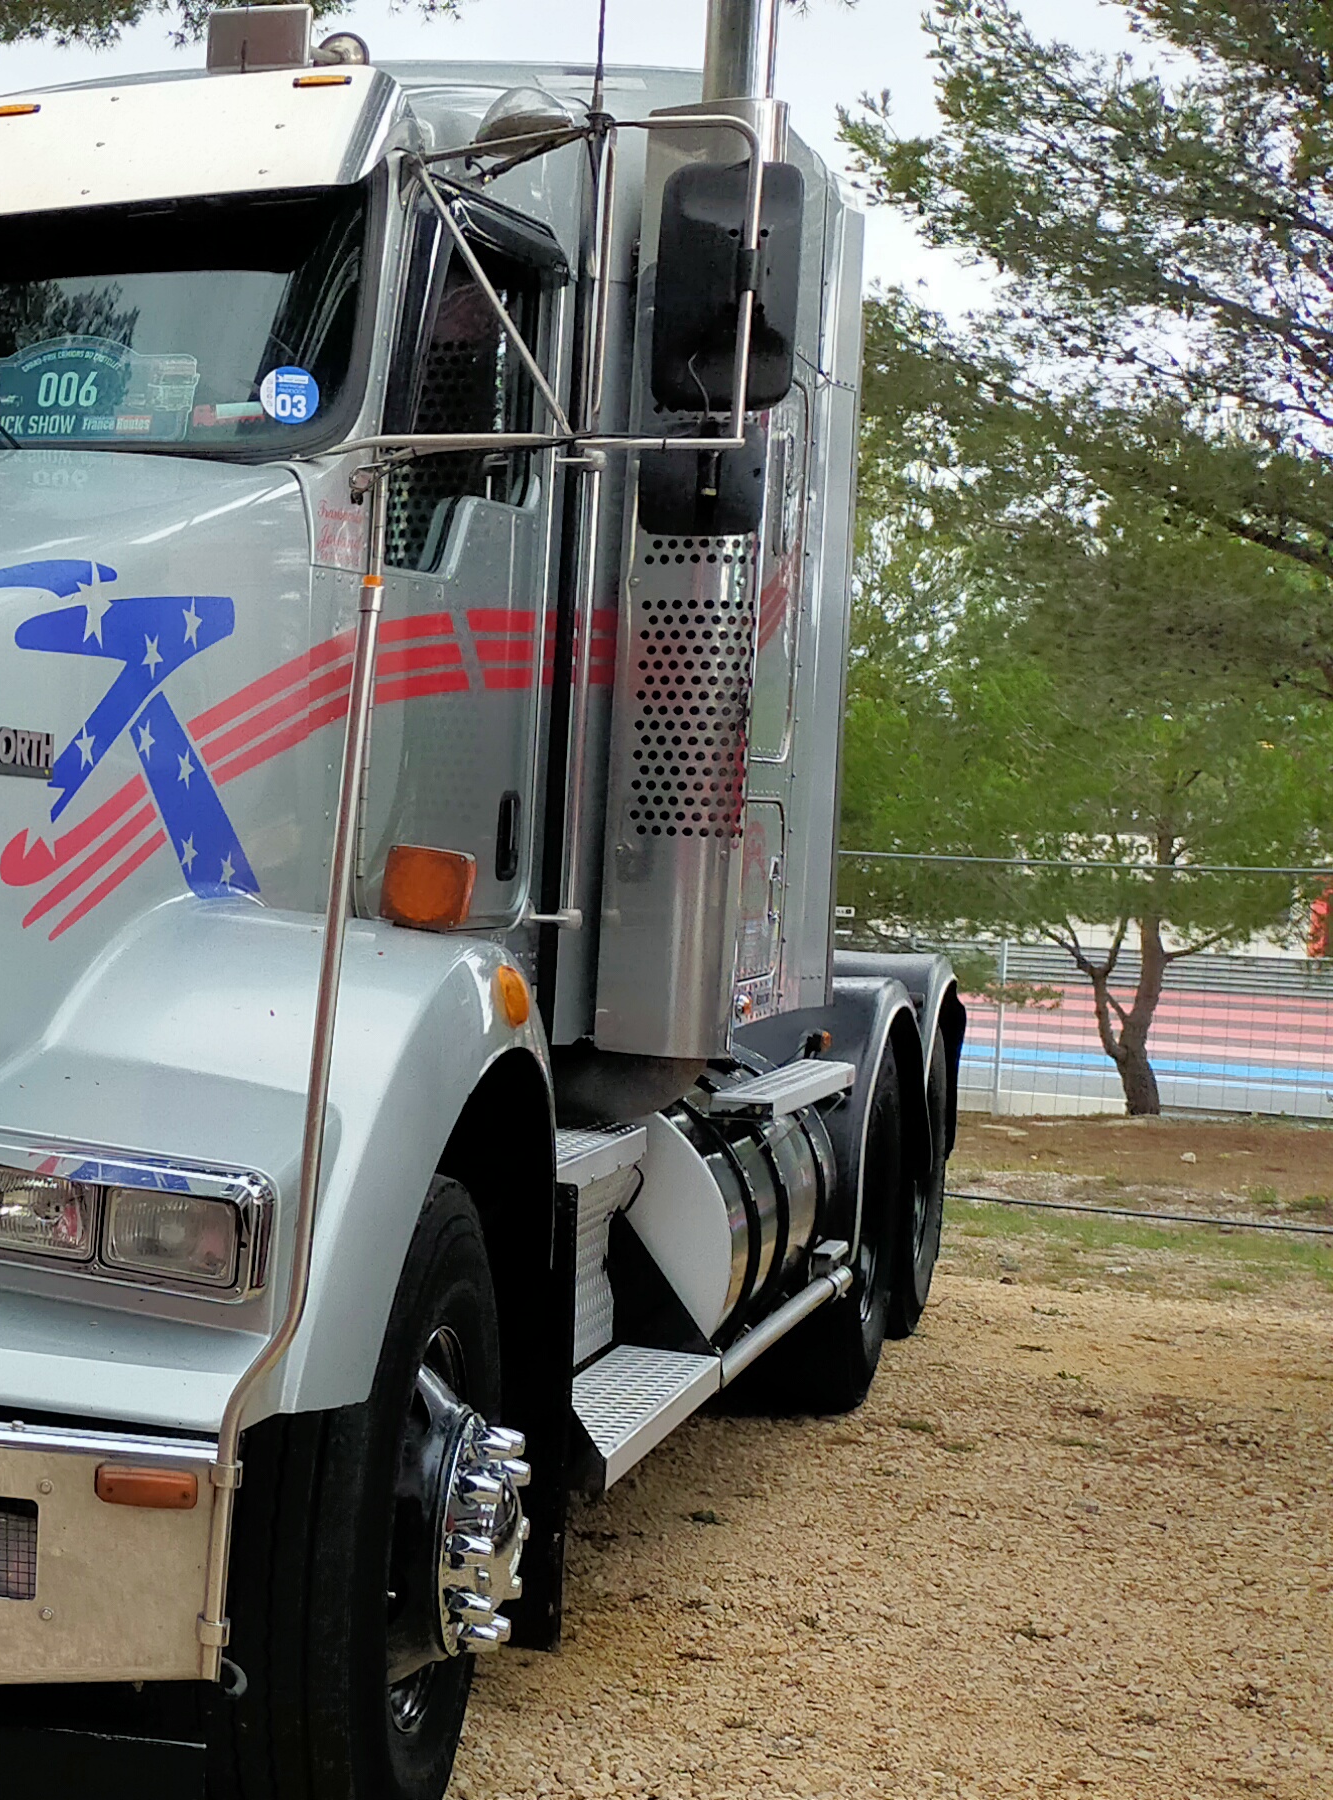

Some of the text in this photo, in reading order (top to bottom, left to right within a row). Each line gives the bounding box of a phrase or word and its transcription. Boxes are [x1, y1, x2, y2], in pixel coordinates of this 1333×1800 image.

[37, 371, 99, 408] 006
[276, 393, 307, 418] 03
[28, 415, 76, 434] SHOW
[82, 417, 150, 430] France Routes
